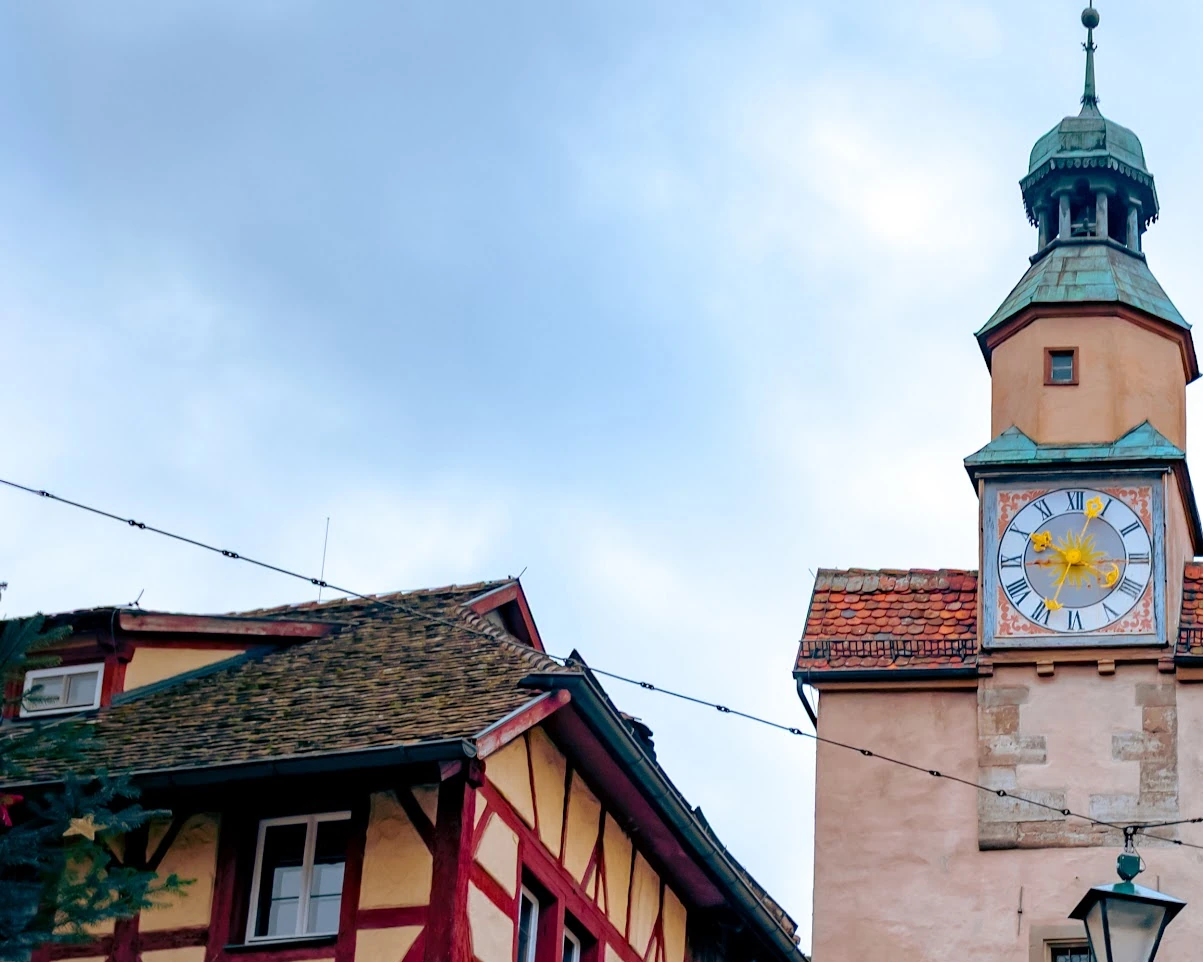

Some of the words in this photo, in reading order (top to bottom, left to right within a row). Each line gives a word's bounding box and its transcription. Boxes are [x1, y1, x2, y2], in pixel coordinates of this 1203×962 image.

[1033, 499, 1053, 520] XI
[1066, 491, 1085, 511] XII
[1119, 521, 1140, 537] II
[1001, 554, 1022, 568] IX
[1129, 553, 1149, 564] III
[1068, 610, 1084, 630] VI
